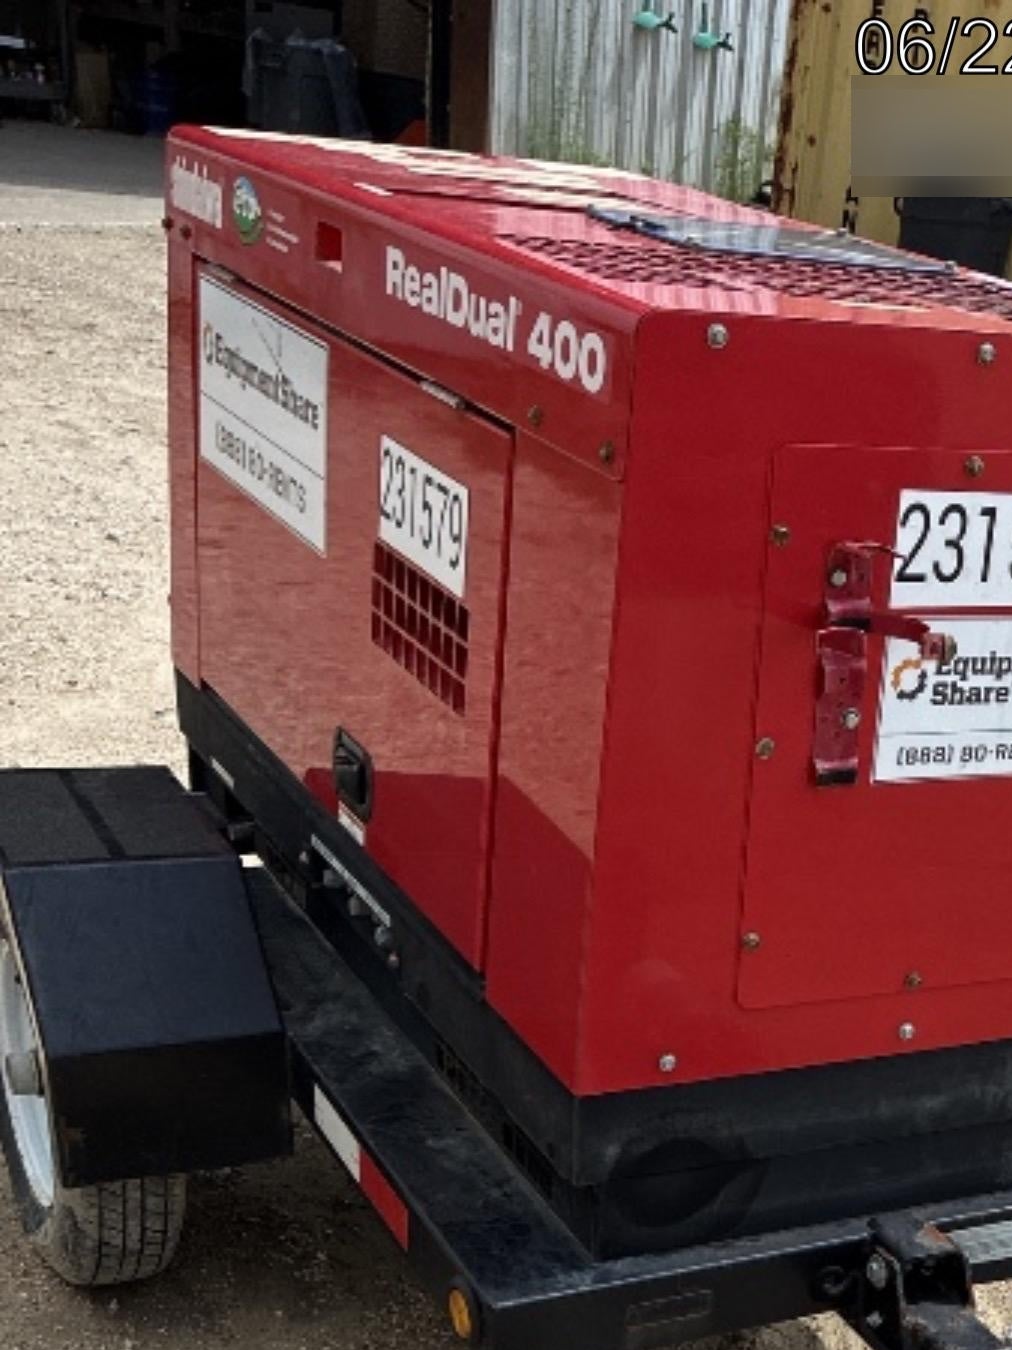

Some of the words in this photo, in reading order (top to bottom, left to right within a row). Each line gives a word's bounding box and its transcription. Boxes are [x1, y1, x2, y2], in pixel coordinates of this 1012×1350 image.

[385, 245, 515, 353] RealDual
[527, 311, 607, 393] 400
[380, 448, 463, 571] 231579
[930, 680, 1010, 706] Share
[896, 744, 955, 767] (888)
